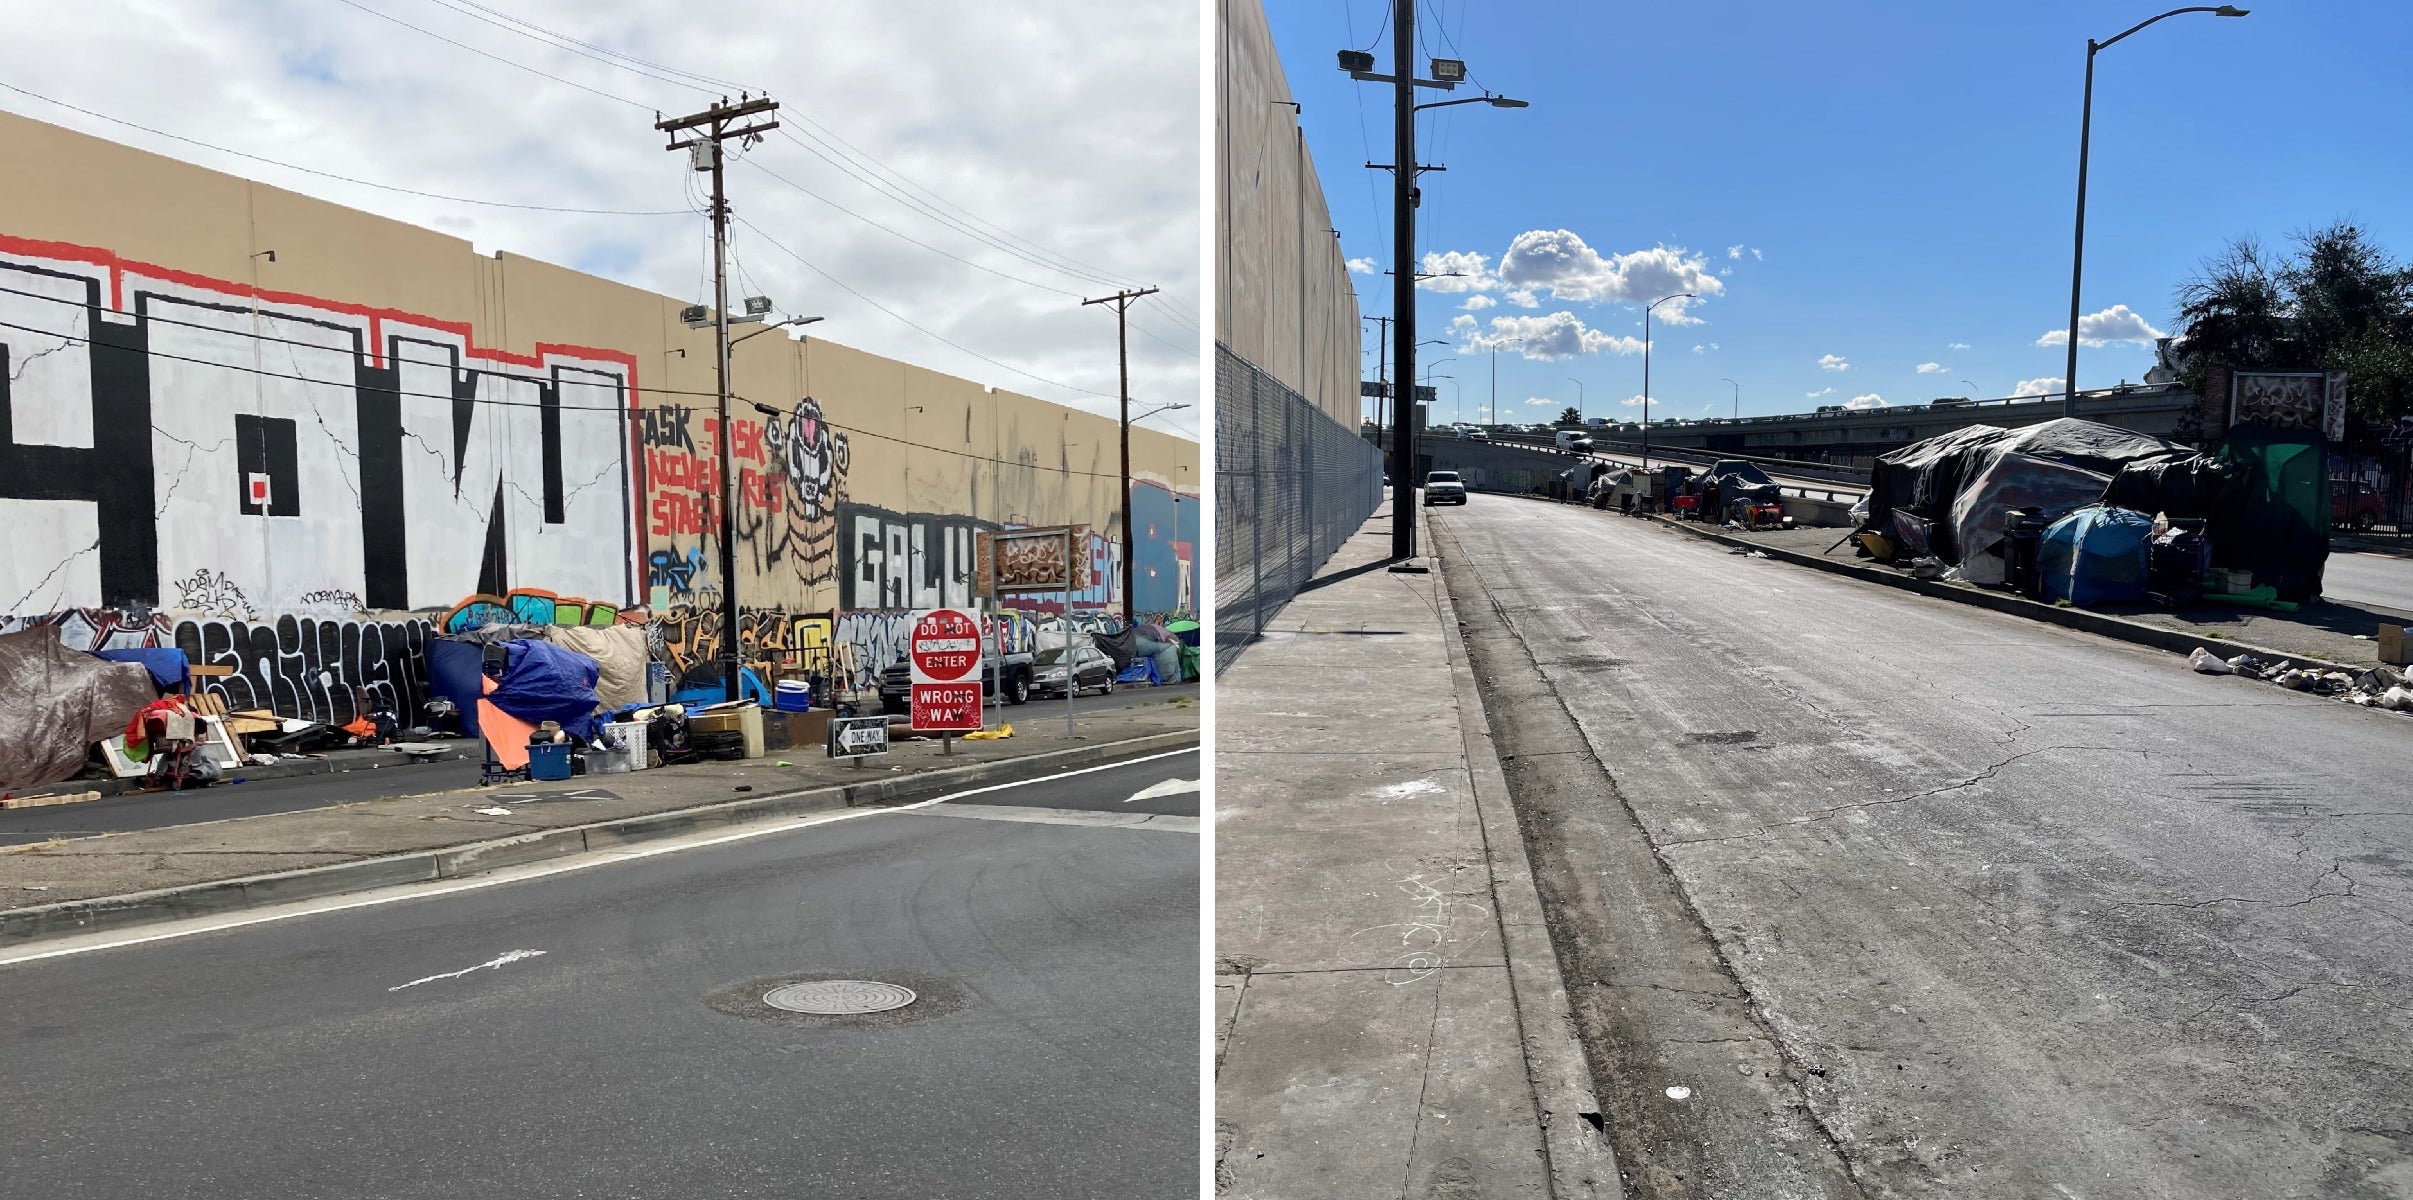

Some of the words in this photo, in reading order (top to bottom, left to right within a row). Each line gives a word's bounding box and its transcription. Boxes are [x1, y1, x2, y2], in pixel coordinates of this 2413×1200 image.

[855, 515, 986, 609] GALU
[921, 624, 938, 636] DO
[945, 622, 971, 635] NOT
[926, 655, 967, 668] ENTER
[920, 690, 974, 704] WRONG
[930, 708, 962, 722] WAY
[851, 731, 865, 744] ONE
[867, 729, 880, 742] WAY
